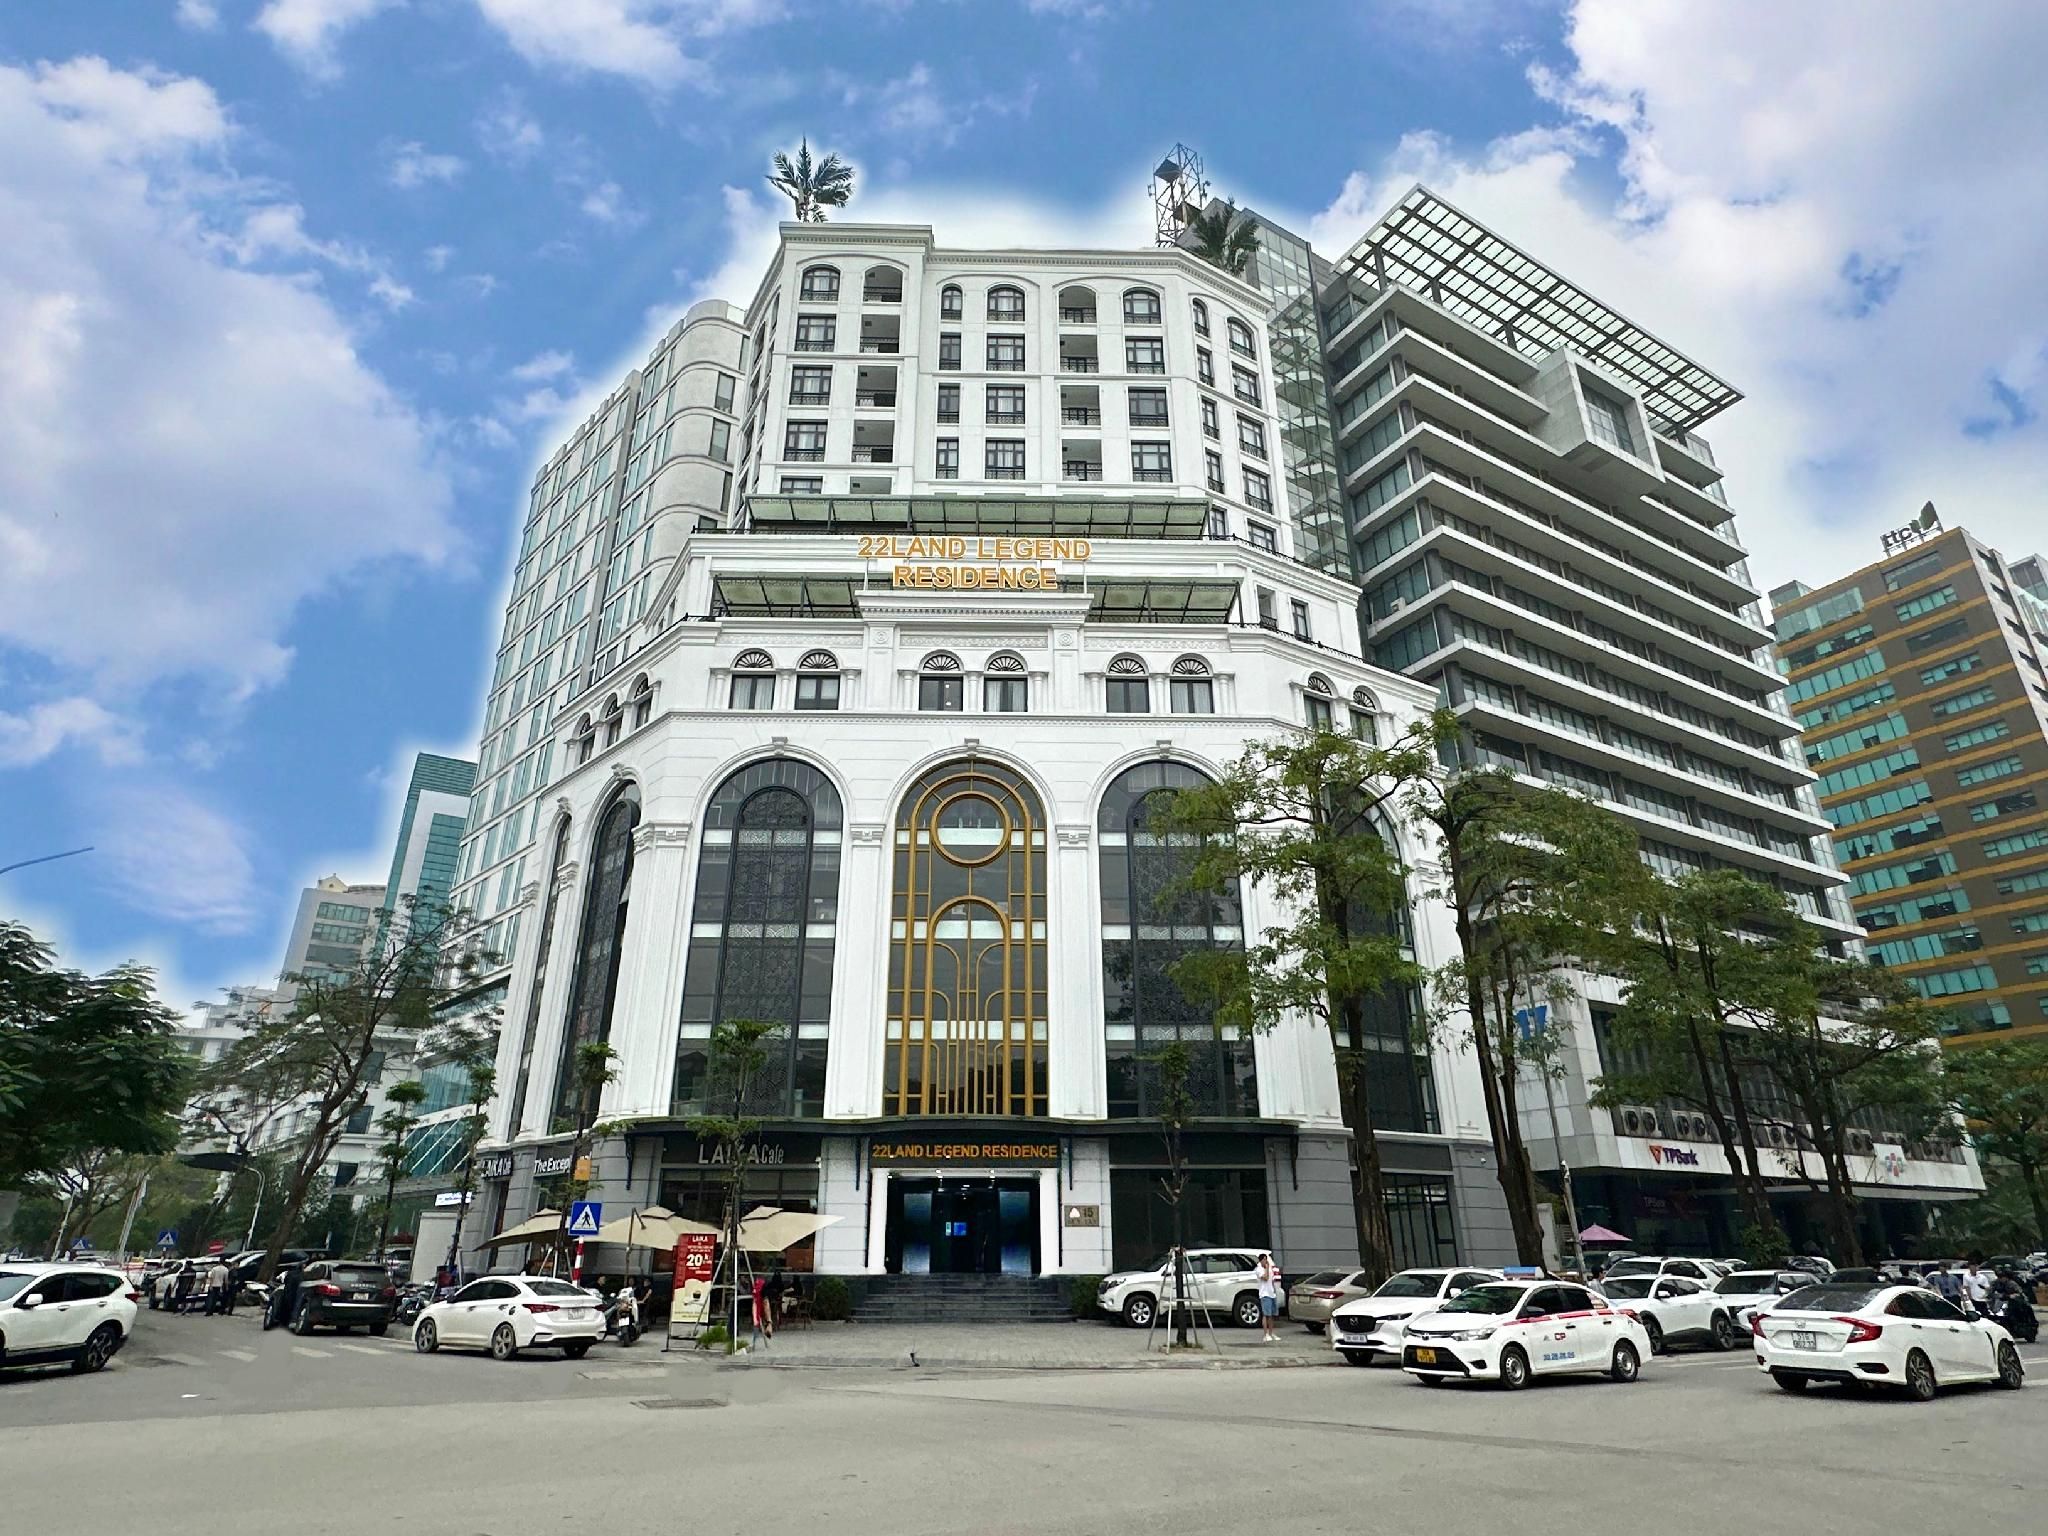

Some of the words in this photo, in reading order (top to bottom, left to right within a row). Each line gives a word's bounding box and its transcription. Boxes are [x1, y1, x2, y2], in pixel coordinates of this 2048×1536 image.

[857, 535, 967, 559] 22LAND
[976, 537, 1092, 560] LEGEND
[893, 564, 1057, 589] RESIDENCE
[872, 1145, 922, 1157] 22LAND
[926, 1145, 979, 1157] LEGEND
[983, 1144, 1057, 1158] RESIDENCE
[1663, 1147, 1699, 1165] TPBank
[534, 1159, 546, 1175] The
